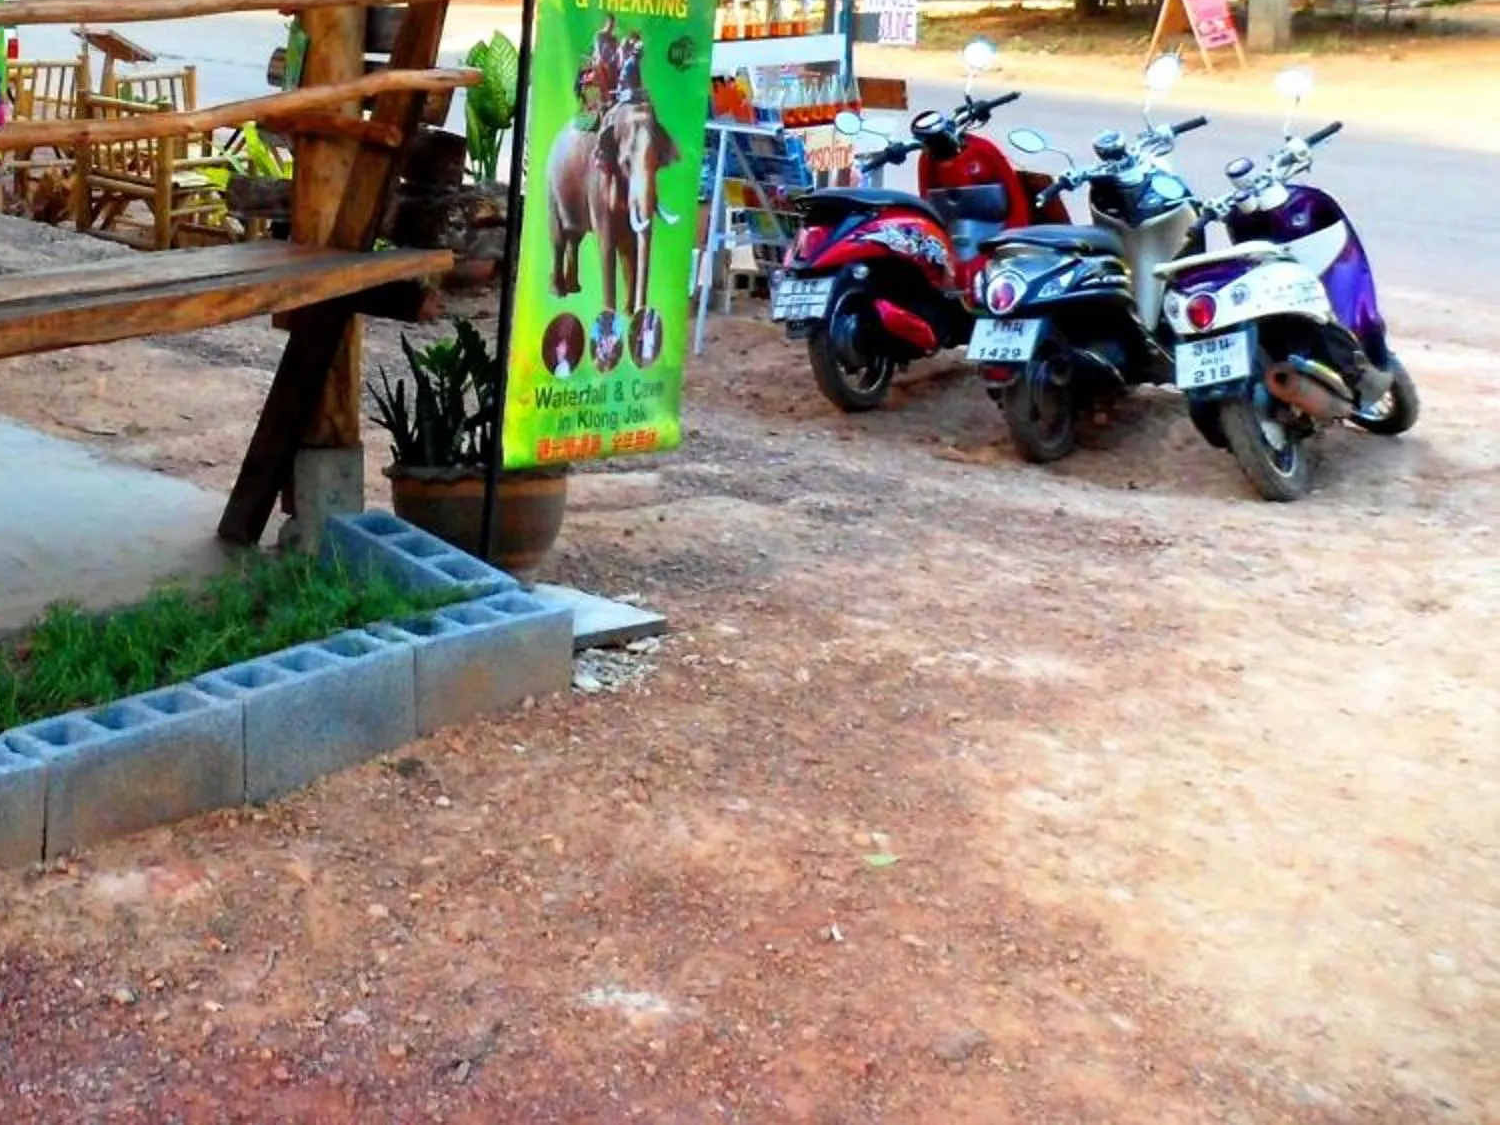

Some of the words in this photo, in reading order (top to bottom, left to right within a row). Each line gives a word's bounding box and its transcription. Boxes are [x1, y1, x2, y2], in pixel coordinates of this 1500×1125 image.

[979, 347, 1022, 358] 1429
[1193, 365, 1231, 384] 218
[535, 383, 608, 409] Waterfall
[613, 381, 624, 402] &
[557, 415, 572, 432] in
[577, 409, 619, 430] Klong
[624, 405, 647, 424] Jak
